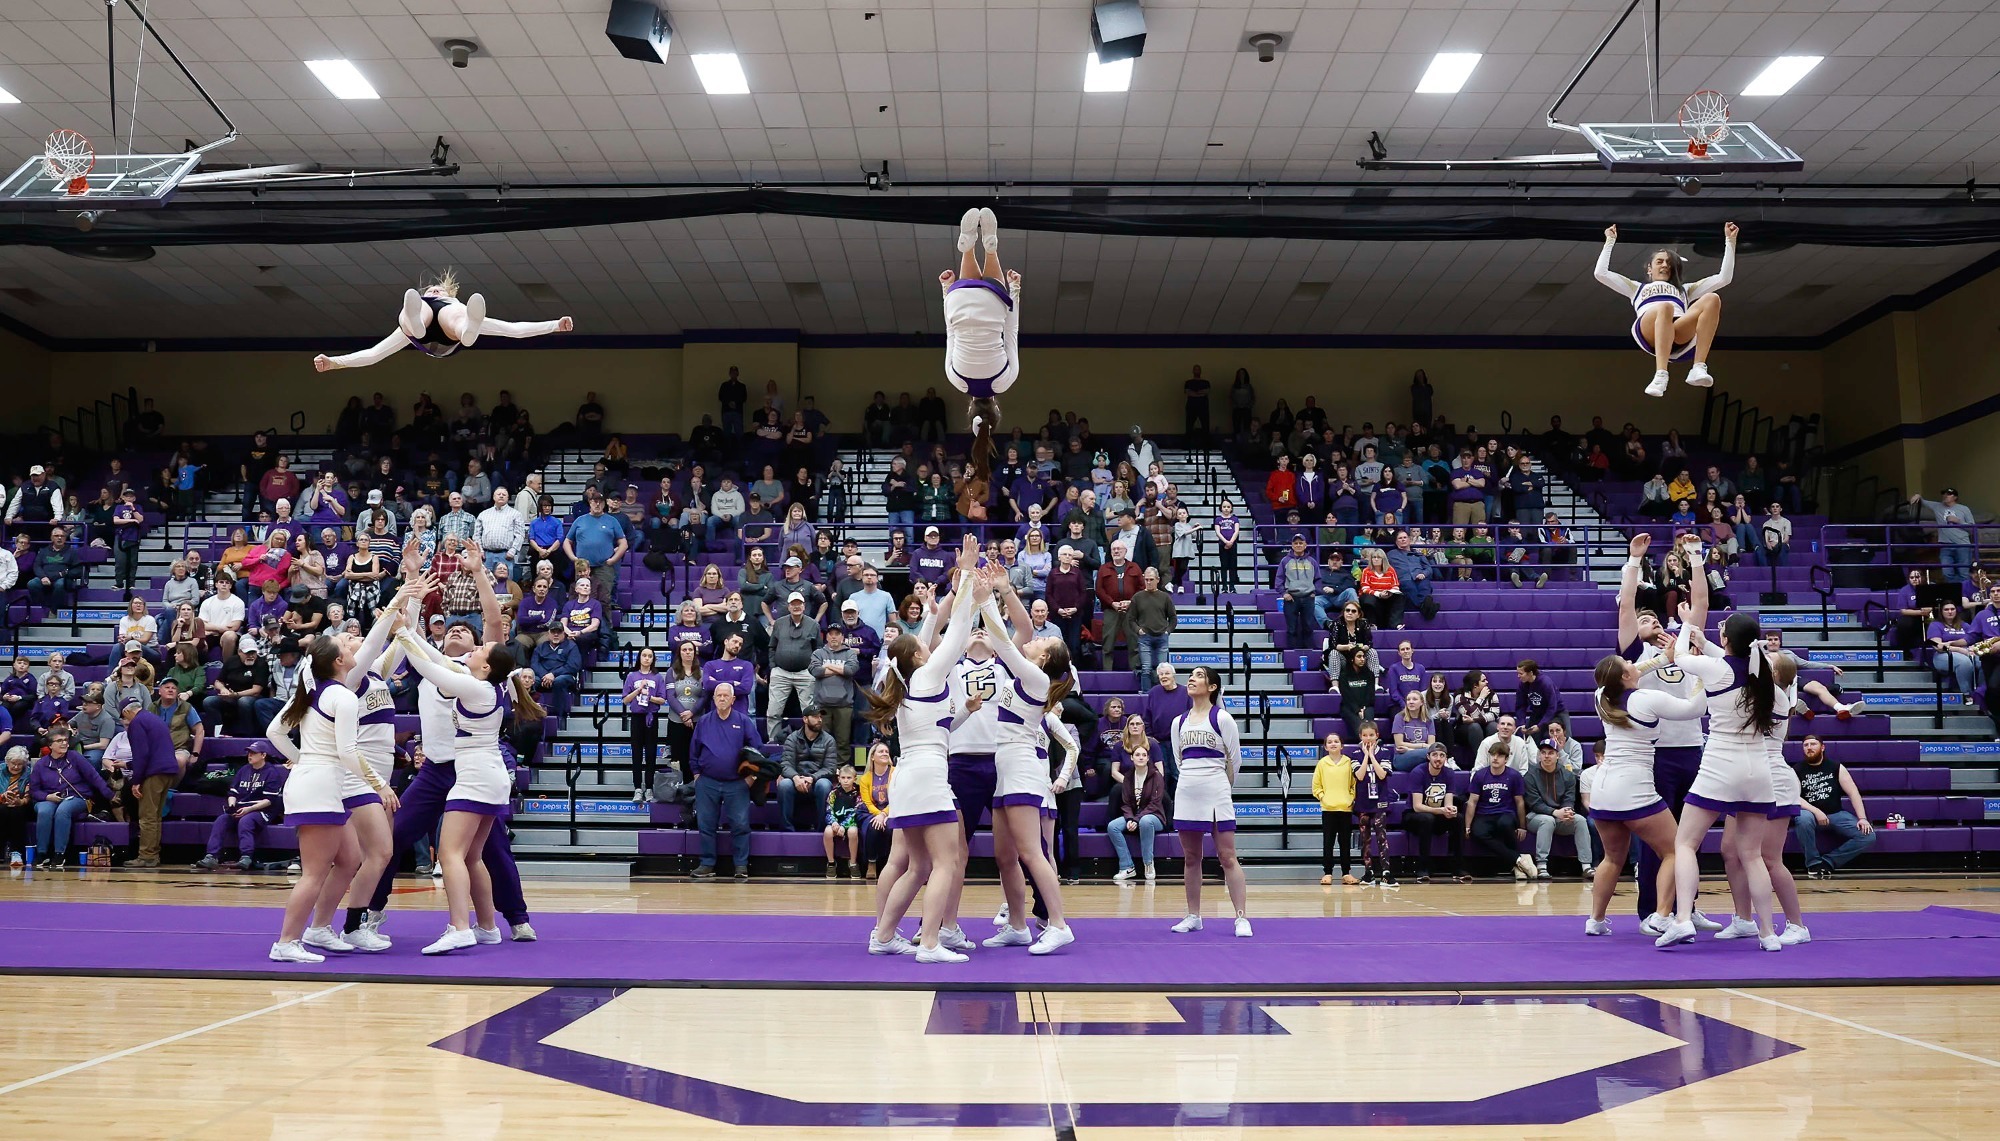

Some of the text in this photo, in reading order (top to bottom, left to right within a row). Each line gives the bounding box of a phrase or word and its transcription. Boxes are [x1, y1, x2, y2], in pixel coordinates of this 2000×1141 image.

[366, 689, 392, 710] SAIN
[1180, 730, 1216, 748] AINTS
[1482, 783, 1508, 791] CARROLL
[542, 803, 561, 811] pepsi
